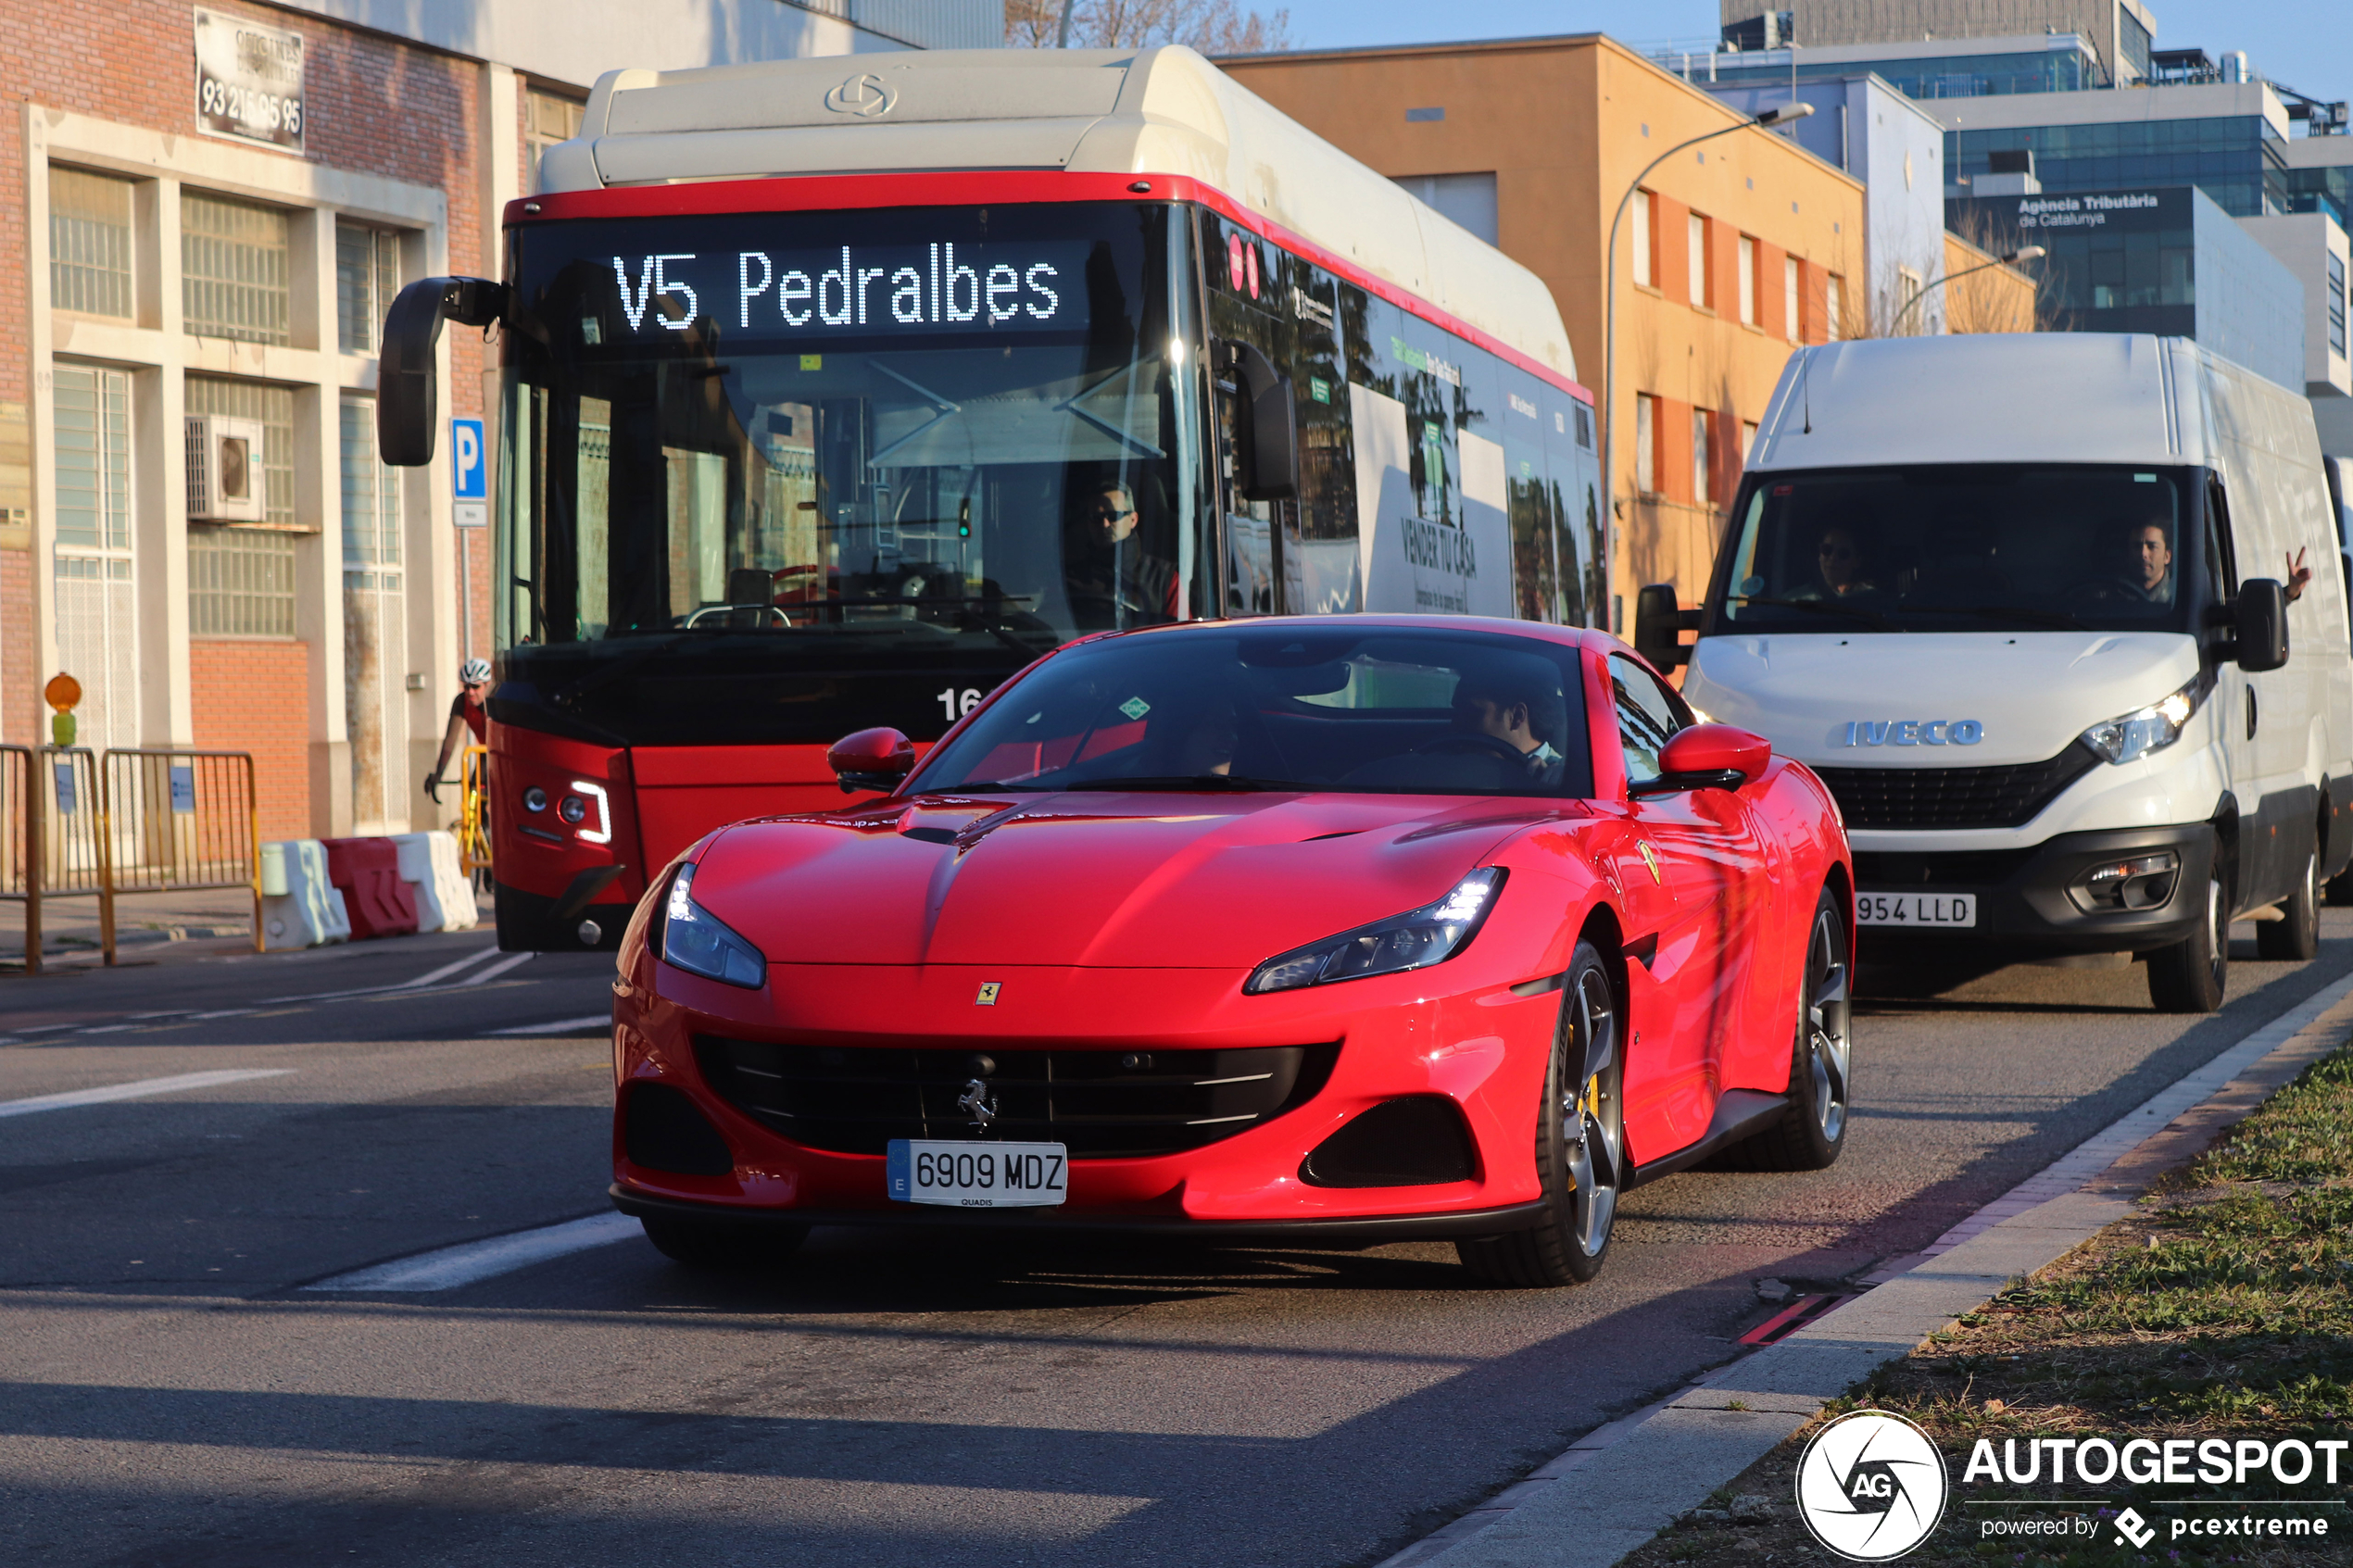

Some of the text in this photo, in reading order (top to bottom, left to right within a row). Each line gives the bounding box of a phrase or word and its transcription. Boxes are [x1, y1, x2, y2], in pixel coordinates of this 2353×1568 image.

[202, 78, 226, 116] 93
[258, 93, 281, 129] 95
[282, 97, 301, 133] 95
[2019, 194, 2158, 214] Agència Tributària
[2019, 212, 2106, 228] de Catalunya
[612, 242, 1059, 332] V5 Pedralbes
[456, 425, 479, 491] P
[1401, 517, 1477, 580] VENDER TU CASA
[937, 688, 988, 721] 16
[1845, 719, 1984, 747] IVECO
[1857, 897, 1967, 922] 954 LLD
[895, 1179, 904, 1191] E
[917, 1152, 1063, 1190] 6909 MDZ
[961, 1198, 993, 1207] QUADIS
